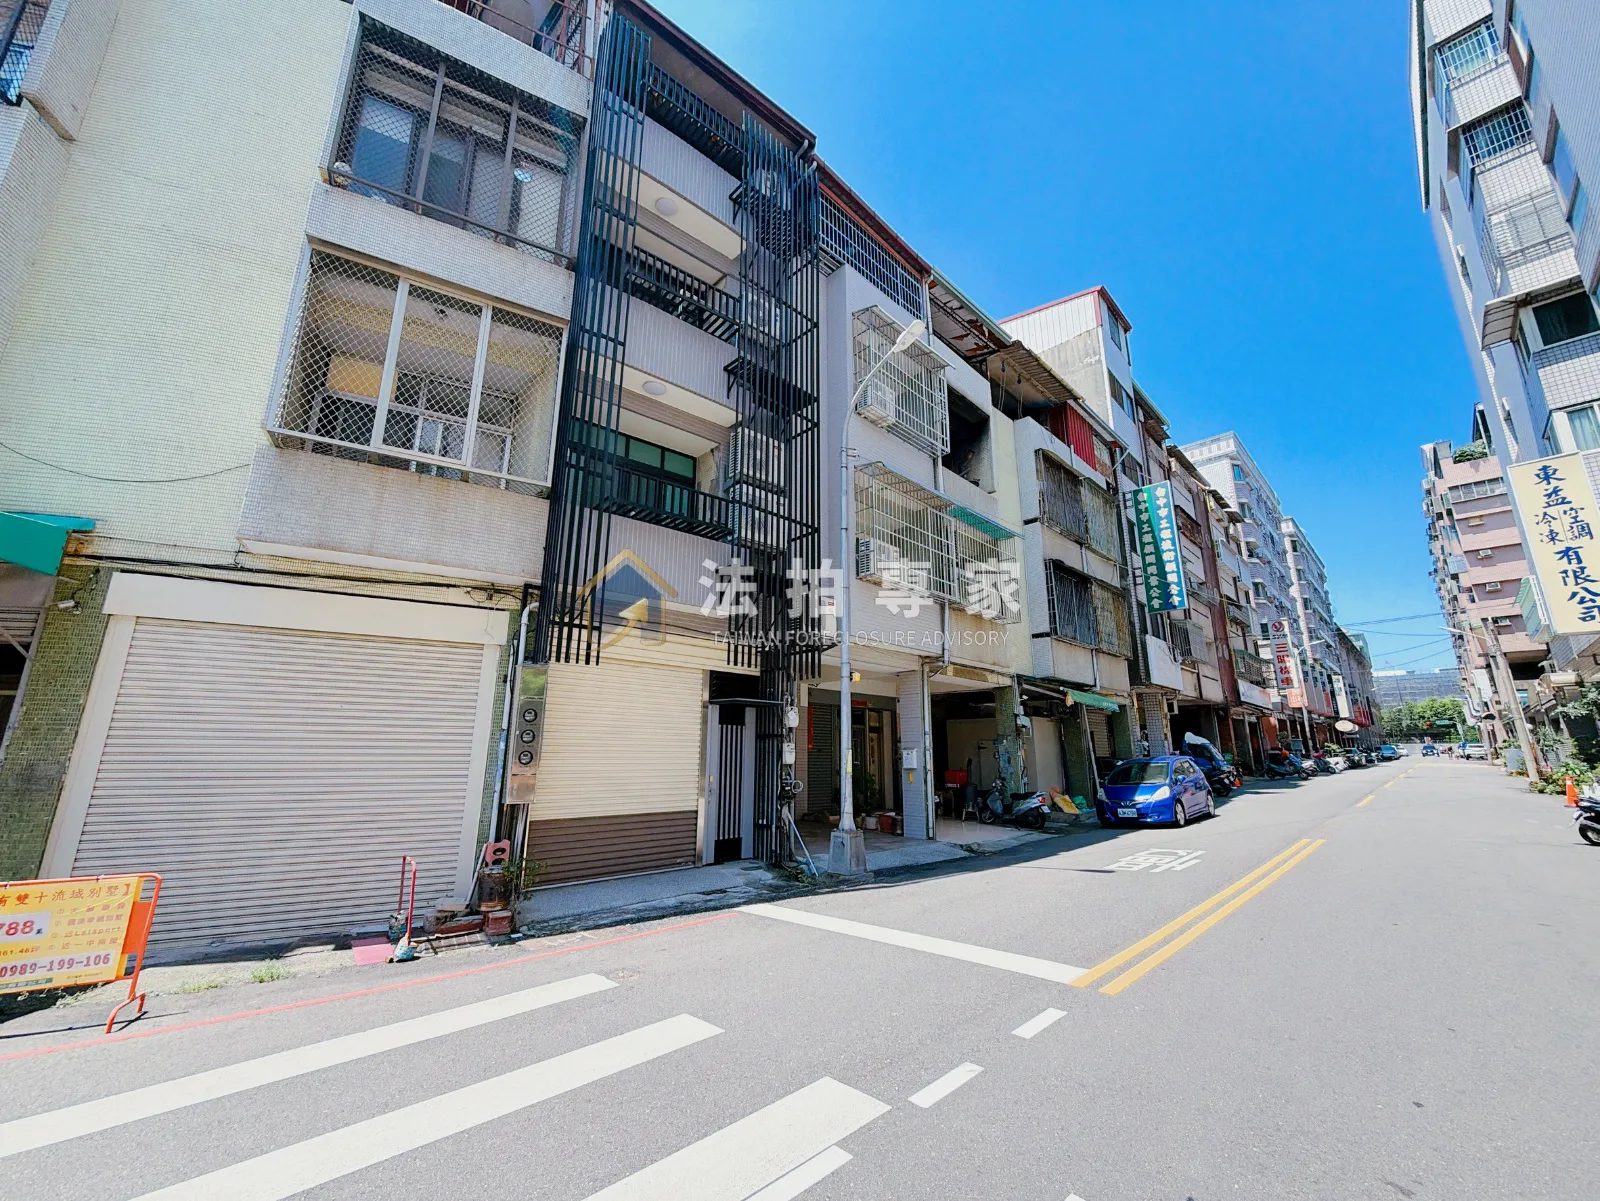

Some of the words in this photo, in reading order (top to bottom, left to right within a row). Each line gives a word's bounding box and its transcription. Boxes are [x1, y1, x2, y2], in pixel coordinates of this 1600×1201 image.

[1534, 511, 1565, 545] 冷凍
[1562, 507, 1594, 541] 空調
[0, 953, 110, 978] 0989-199-106
